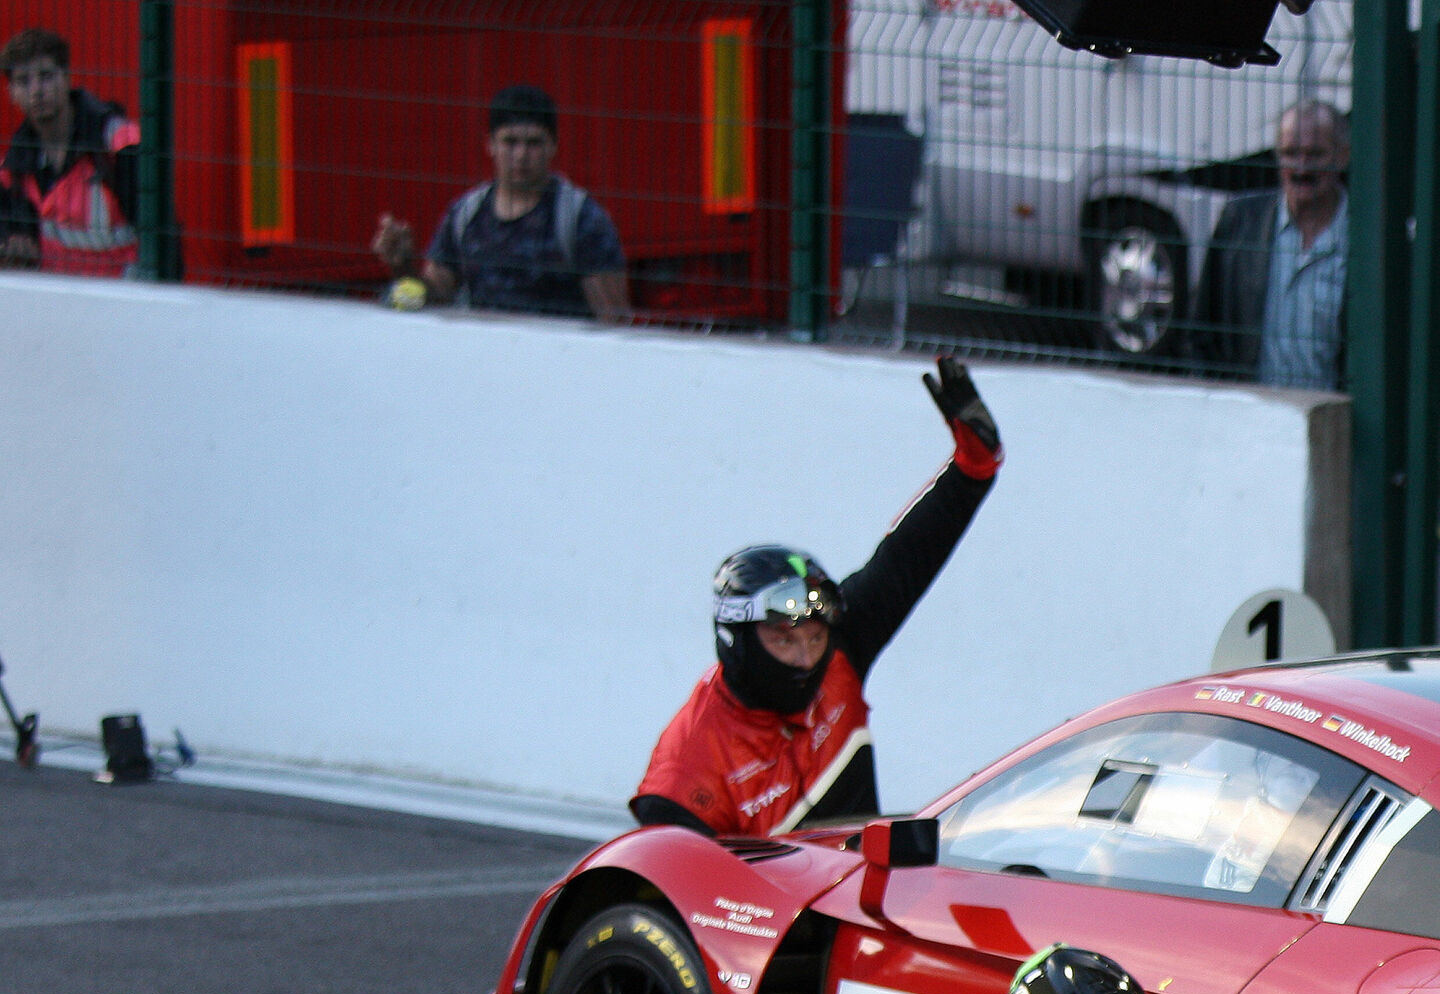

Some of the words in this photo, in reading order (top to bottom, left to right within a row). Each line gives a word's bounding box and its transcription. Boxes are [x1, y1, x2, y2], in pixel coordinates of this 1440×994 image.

[1247, 599, 1281, 662] 1
[1212, 686, 1246, 704] Rast
[1264, 695, 1322, 724] Vanthoor
[1340, 720, 1412, 762] Winkelhock
[739, 783, 791, 818] TOTAL
[727, 911, 753, 924] Audi
[718, 969, 752, 989] V10
